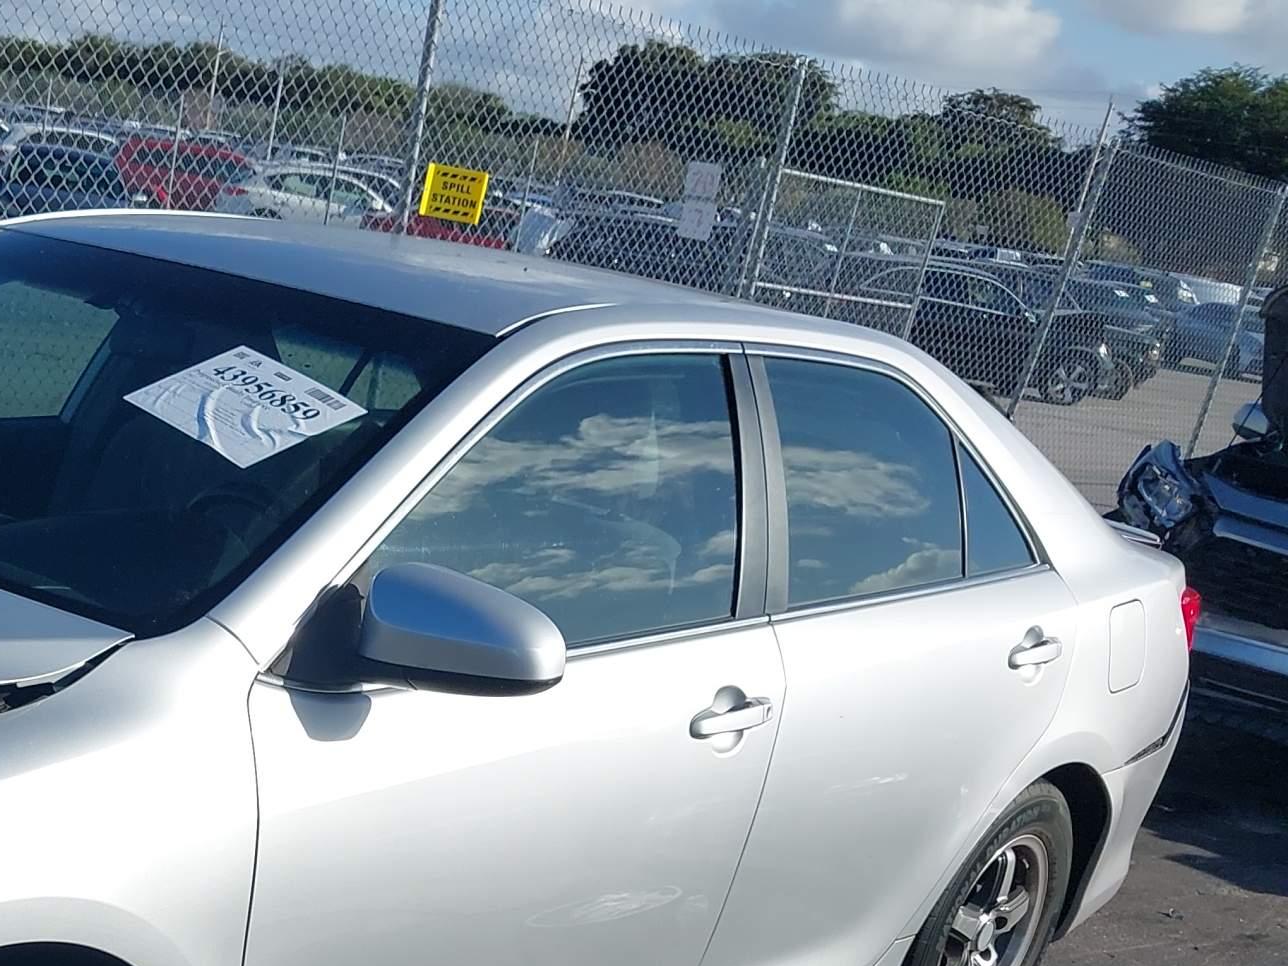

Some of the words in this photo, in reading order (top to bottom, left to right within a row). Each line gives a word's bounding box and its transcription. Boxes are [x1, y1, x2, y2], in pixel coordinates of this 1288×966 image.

[442, 181, 471, 195] SPILL
[432, 192, 477, 208] STATION
[213, 366, 320, 420] 43956859
